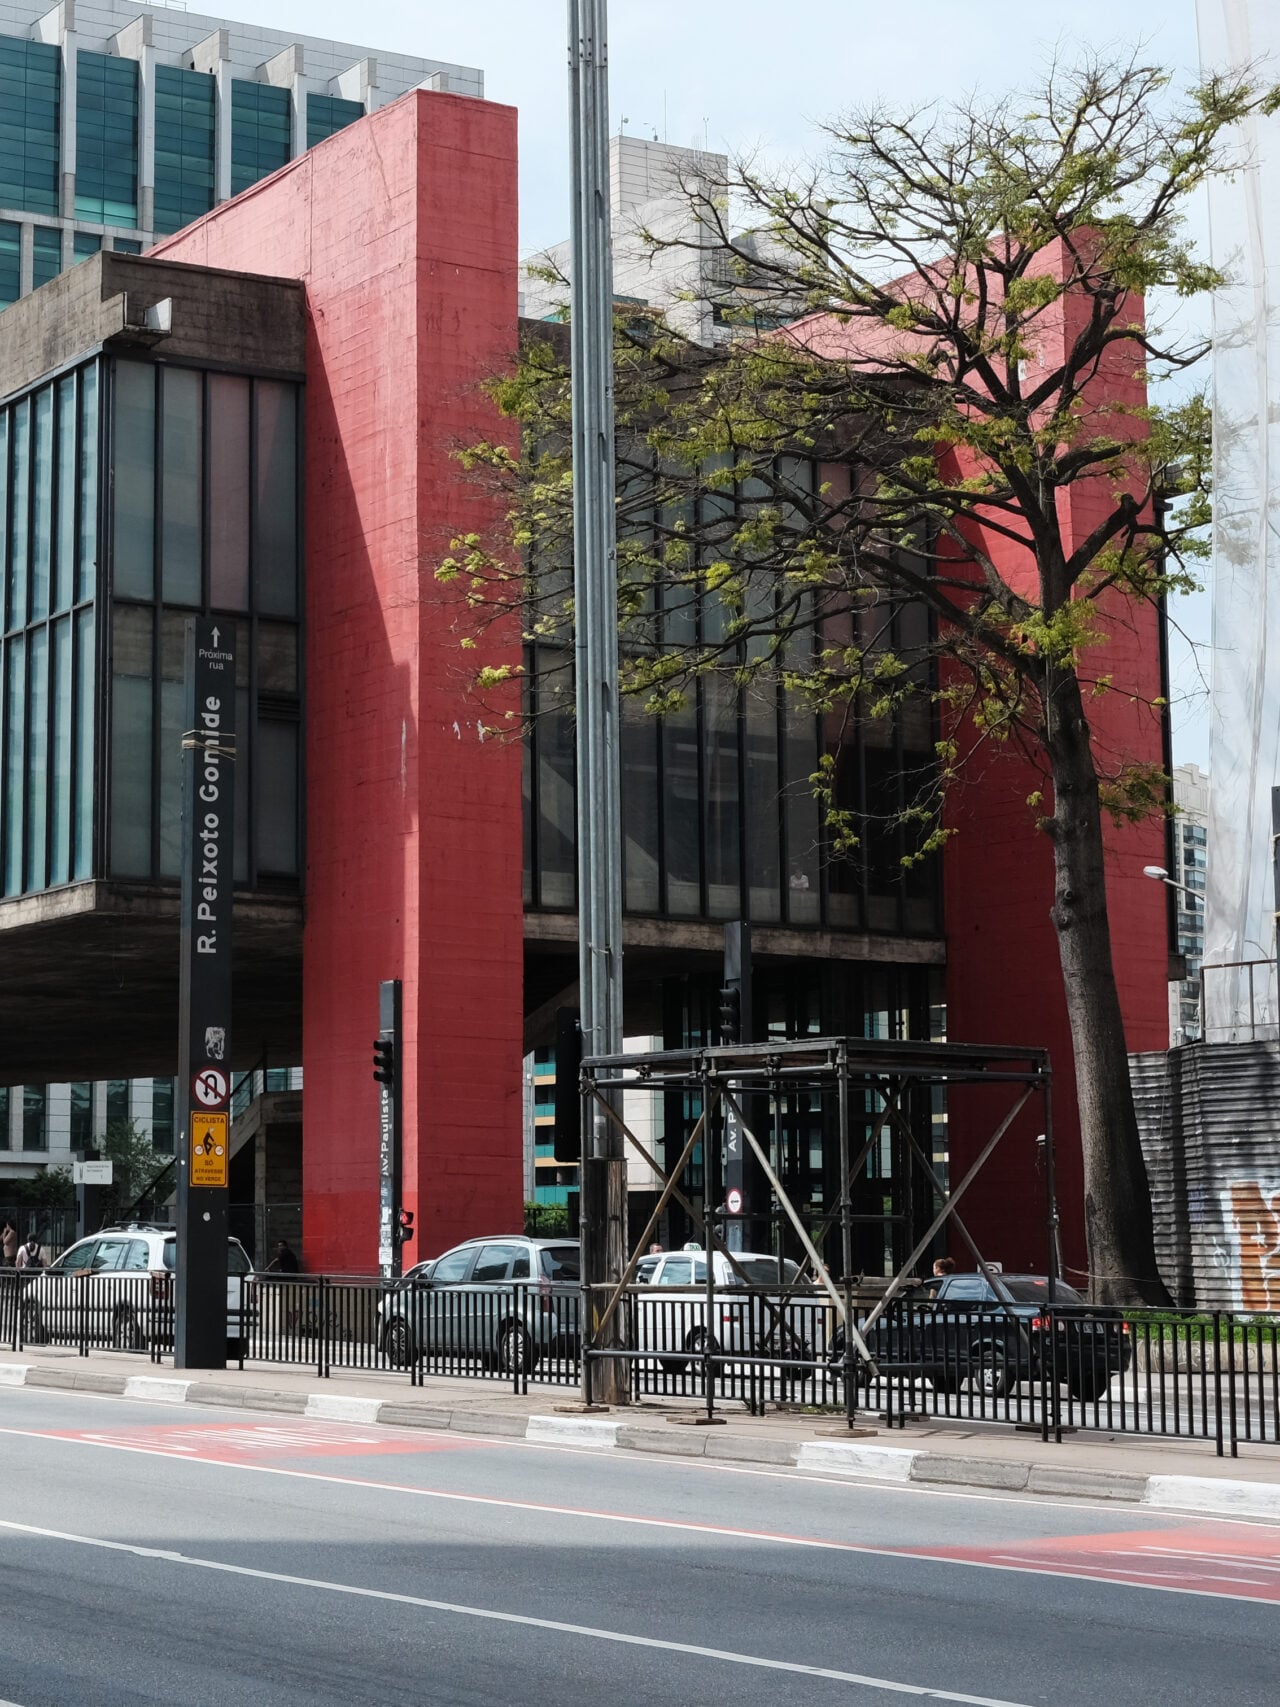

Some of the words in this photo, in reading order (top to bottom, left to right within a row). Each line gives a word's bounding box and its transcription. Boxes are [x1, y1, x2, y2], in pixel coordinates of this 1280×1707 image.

[198, 648, 233, 661] Próxima
[209, 661, 224, 670] rua
[199, 696, 221, 802] Gomide
[196, 813, 219, 921] Peixoto
[196, 930, 217, 954] R.
[380, 1089, 389, 1151] Paulista
[728, 1129, 737, 1152] Av.
